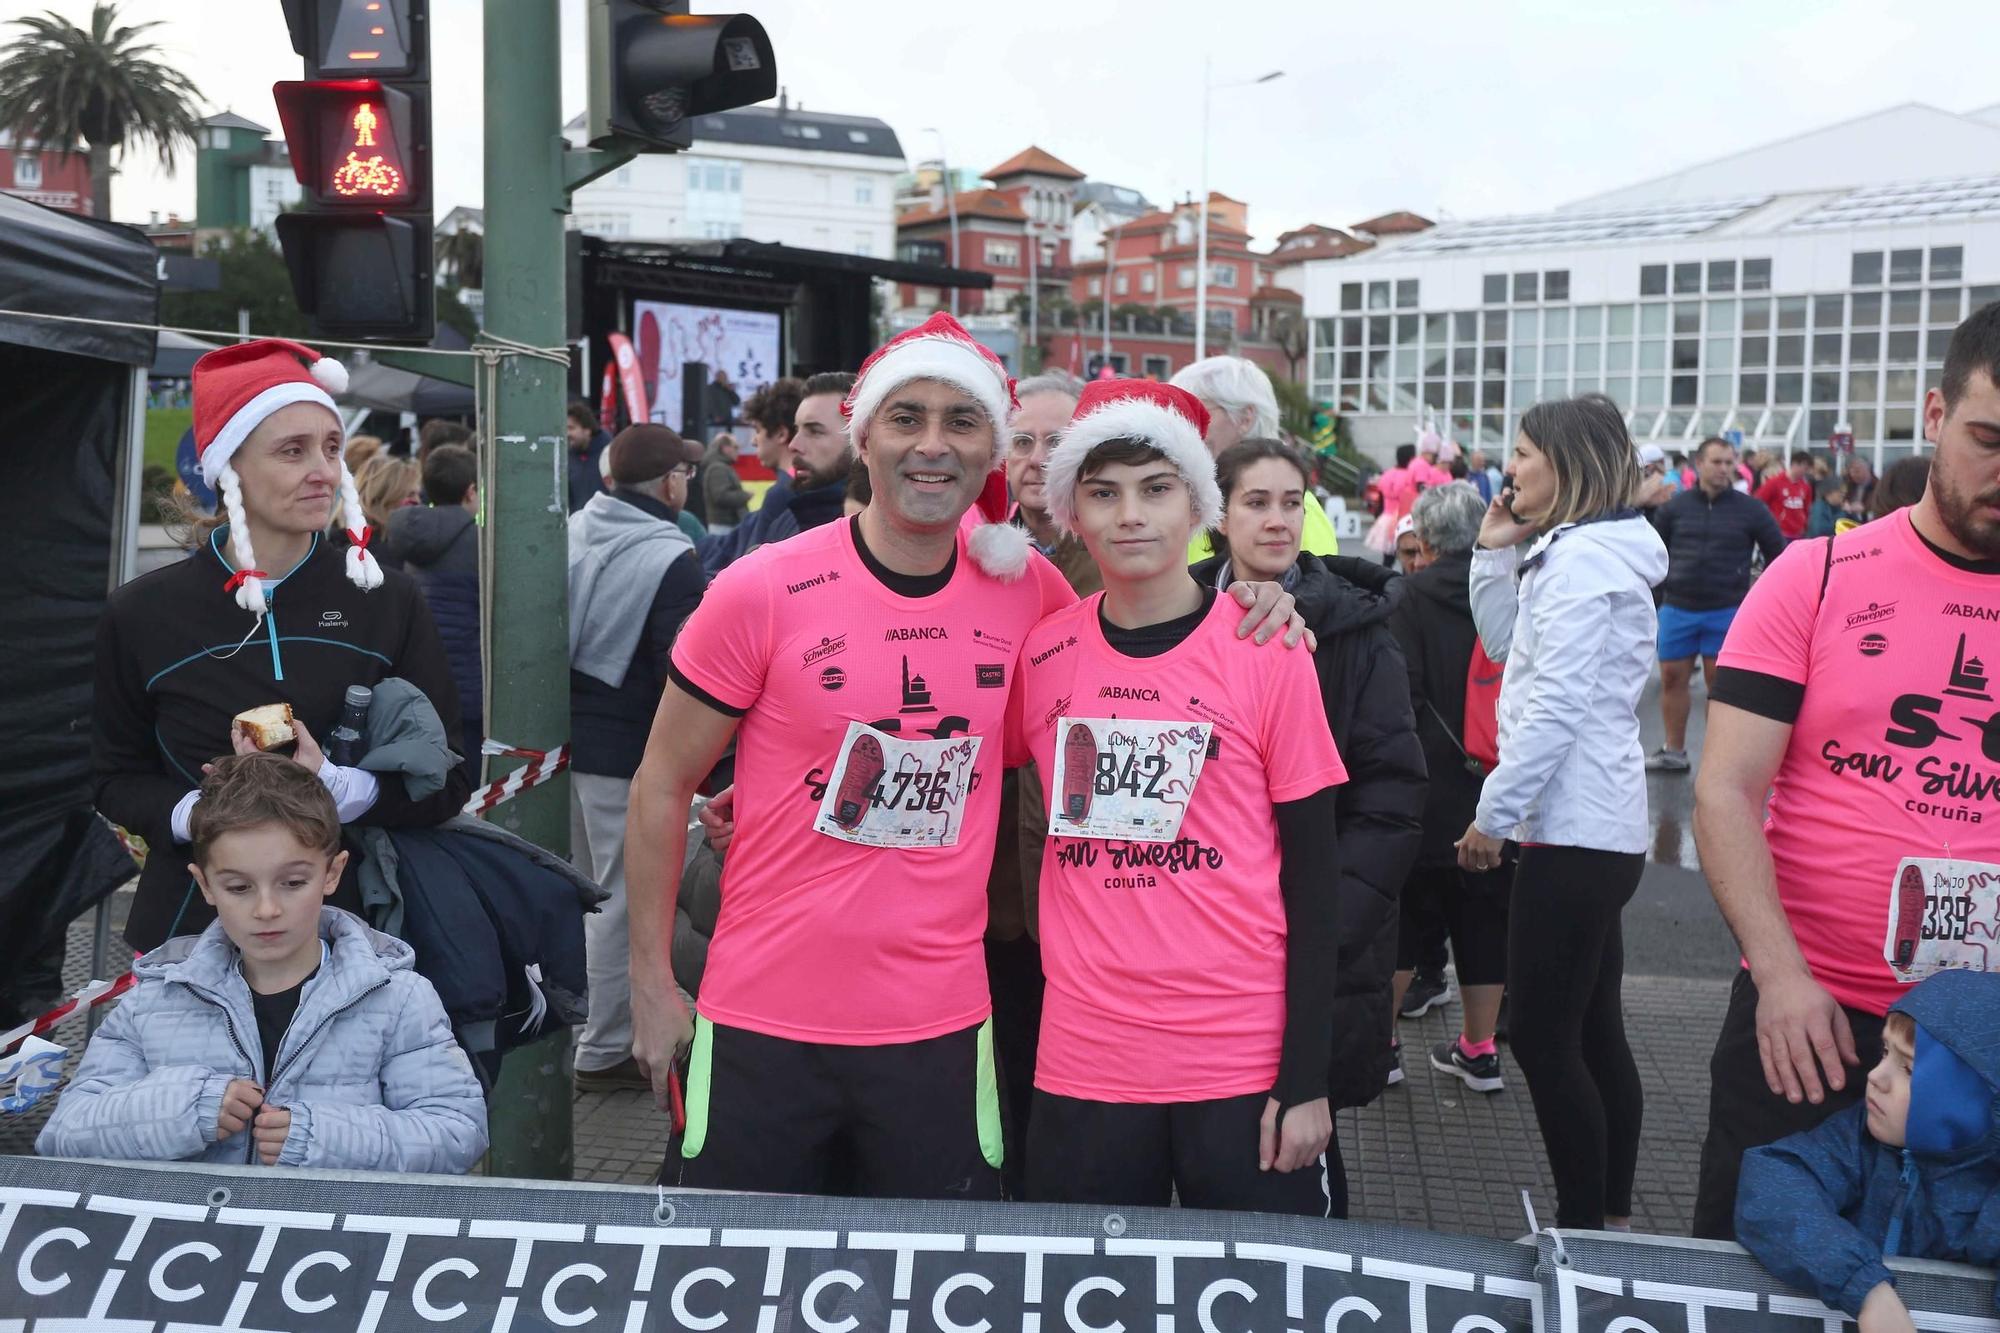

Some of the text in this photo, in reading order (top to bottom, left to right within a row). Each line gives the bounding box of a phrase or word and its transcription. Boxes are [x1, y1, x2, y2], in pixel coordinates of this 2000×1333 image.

[786, 574, 826, 595] luanvi
[1846, 606, 1895, 627] Schweppes
[802, 640, 846, 666] Schweppes
[1030, 641, 1065, 667] luanvi
[1860, 641, 1886, 649] PEPSI
[1108, 735, 1154, 750] LUKA_7
[1822, 740, 1903, 783] San
[1095, 752, 1167, 799] 842
[862, 769, 951, 811] 4736
[1905, 799, 1983, 823] coruña
[1104, 874, 1157, 889] coruña
[1921, 895, 1972, 941] 339
